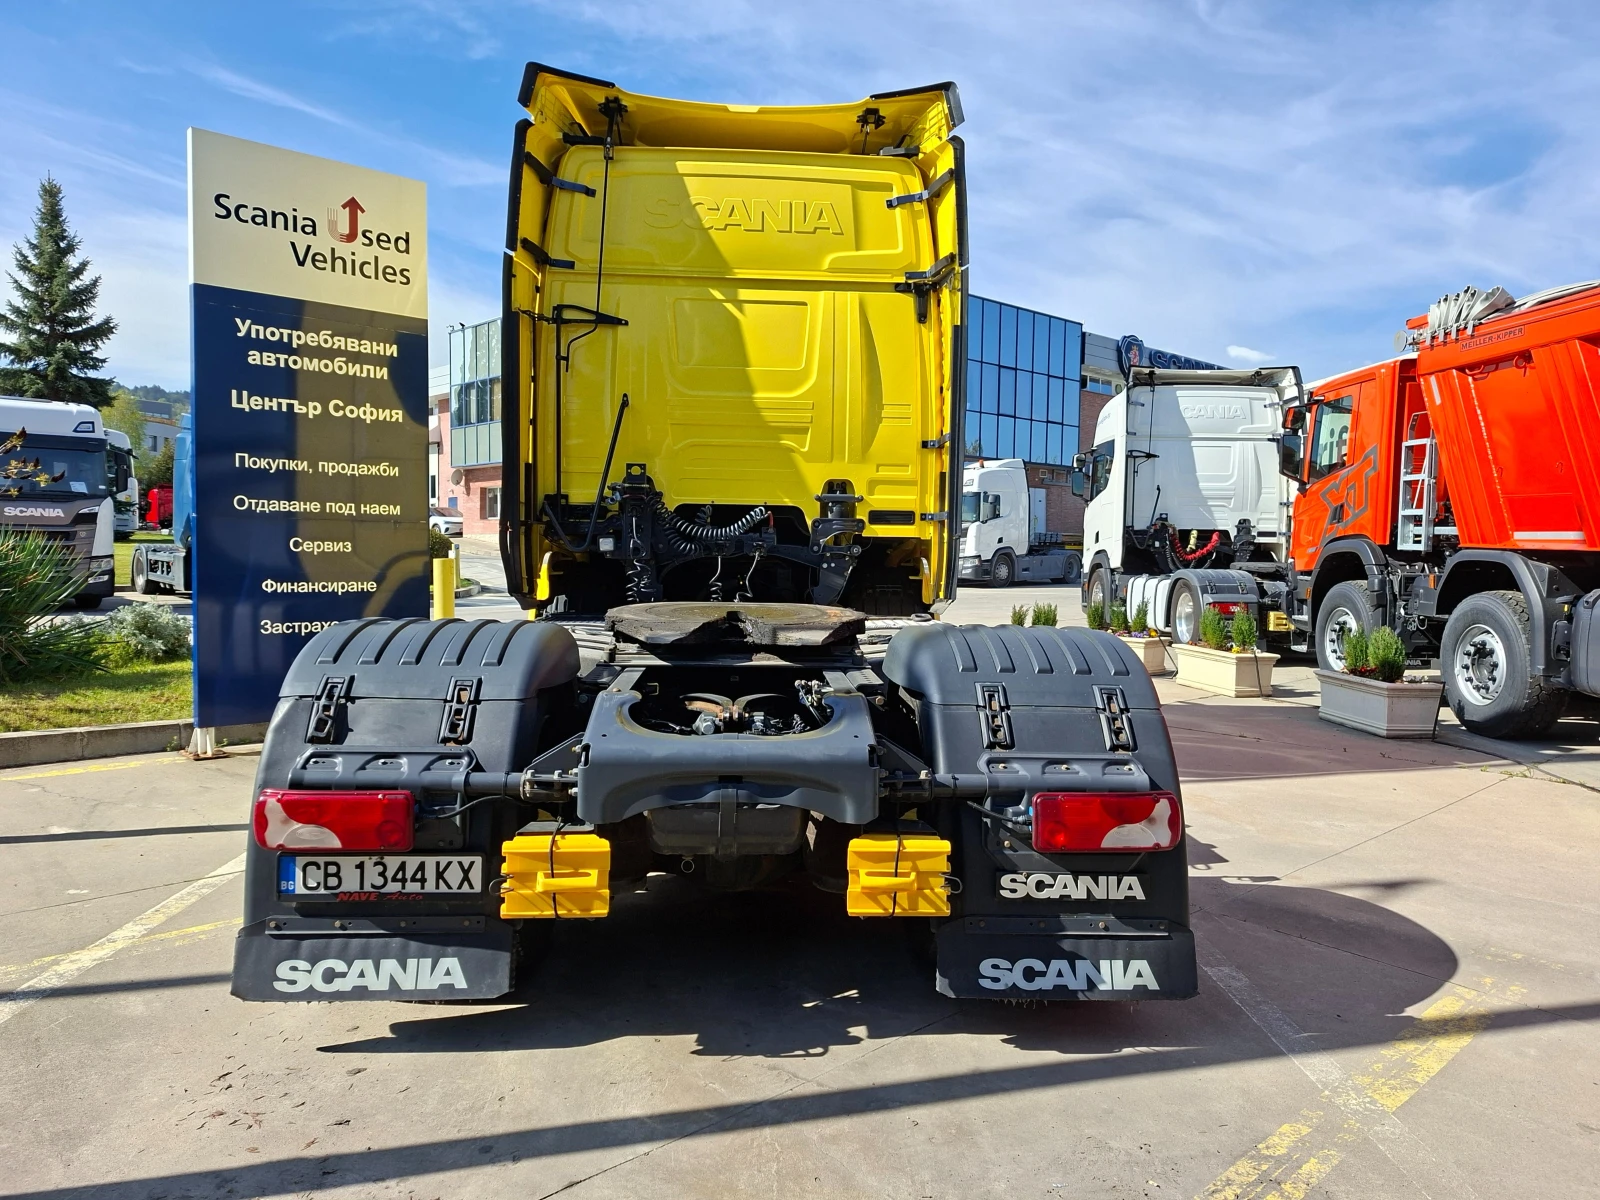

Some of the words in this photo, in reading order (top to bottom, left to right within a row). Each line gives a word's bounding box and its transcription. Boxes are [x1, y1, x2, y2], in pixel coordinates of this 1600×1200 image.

[213, 193, 317, 237] Scania
[644, 196, 844, 236] SCANIA
[290, 241, 411, 286] Vehicles
[235, 318, 398, 357] Употребявани
[1461, 327, 1523, 350] MEILLER-KIPPER
[247, 350, 388, 380] автомобили
[231, 389, 322, 418] Център
[328, 400, 403, 423] София
[1181, 404, 1247, 419] CANIA
[235, 452, 313, 474] Покупки,
[318, 461, 399, 477] продажби
[4, 506, 65, 518] SCANIA
[233, 495, 320, 513] Отдаване
[326, 503, 355, 516] под
[360, 503, 401, 516] наем
[289, 537, 352, 555] Сервиз
[261, 579, 377, 595] Финансиране
[280, 880, 295, 890] BG
[301, 861, 342, 891] CB
[354, 860, 427, 891] 1344
[1000, 873, 1146, 900] SCANIA
[336, 891, 381, 901] NAVE
[383, 890, 424, 901] Auto
[272, 957, 468, 993] SCANIA
[978, 958, 1160, 991] SCANIA
